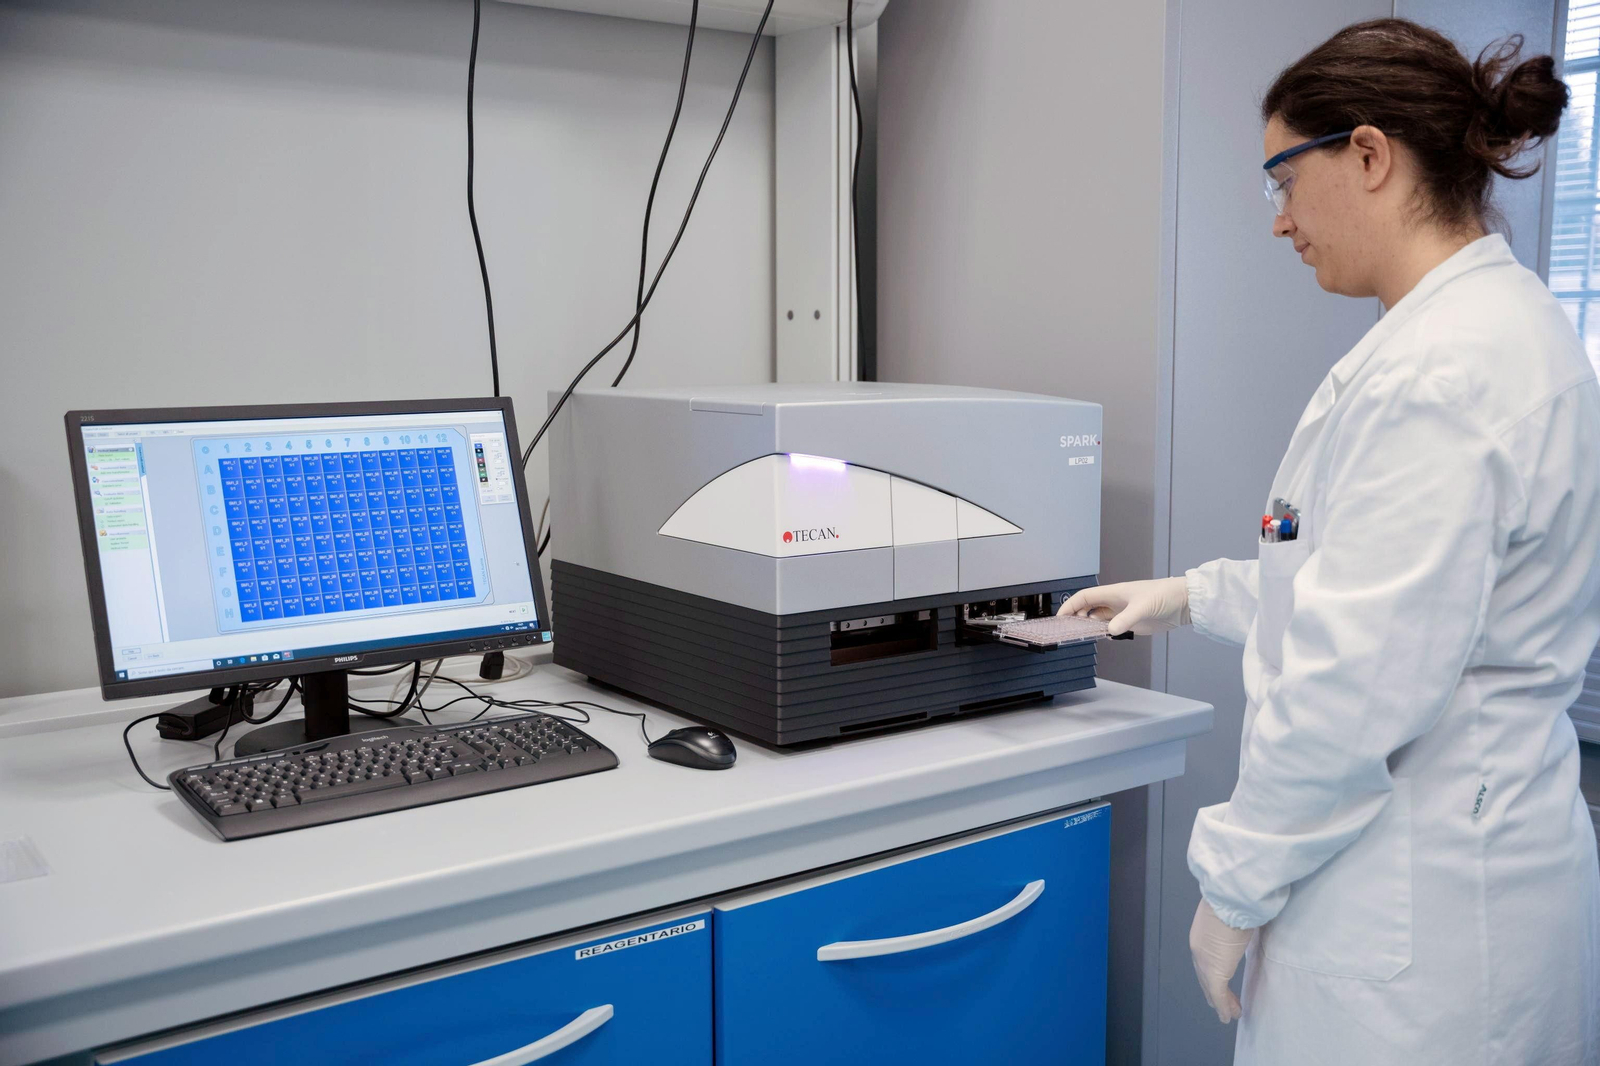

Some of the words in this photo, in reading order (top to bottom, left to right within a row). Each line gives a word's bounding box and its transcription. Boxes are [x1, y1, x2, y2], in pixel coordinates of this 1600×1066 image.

[224, 443, 230, 453] 1
[244, 442, 252, 452] 2
[265, 441, 272, 451] 3
[285, 440, 293, 450] 4
[305, 439, 313, 449] 5
[325, 438, 333, 448] 6
[344, 437, 351, 448] 7
[363, 436, 371, 446] 8
[382, 435, 390, 446] 9
[399, 434, 411, 444] 10
[418, 434, 429, 444] 11
[435, 433, 448, 443] 12
[204, 464, 214, 475] A
[206, 484, 216, 495] B
[209, 504, 219, 515] C
[212, 525, 222, 536] D
[216, 546, 225, 557] E
[219, 567, 227, 577] F
[221, 587, 231, 598] G
[224, 608, 234, 619] H
[334, 655, 358, 663] PHILIPS
[579, 923, 697, 958] REAGENTARIO
